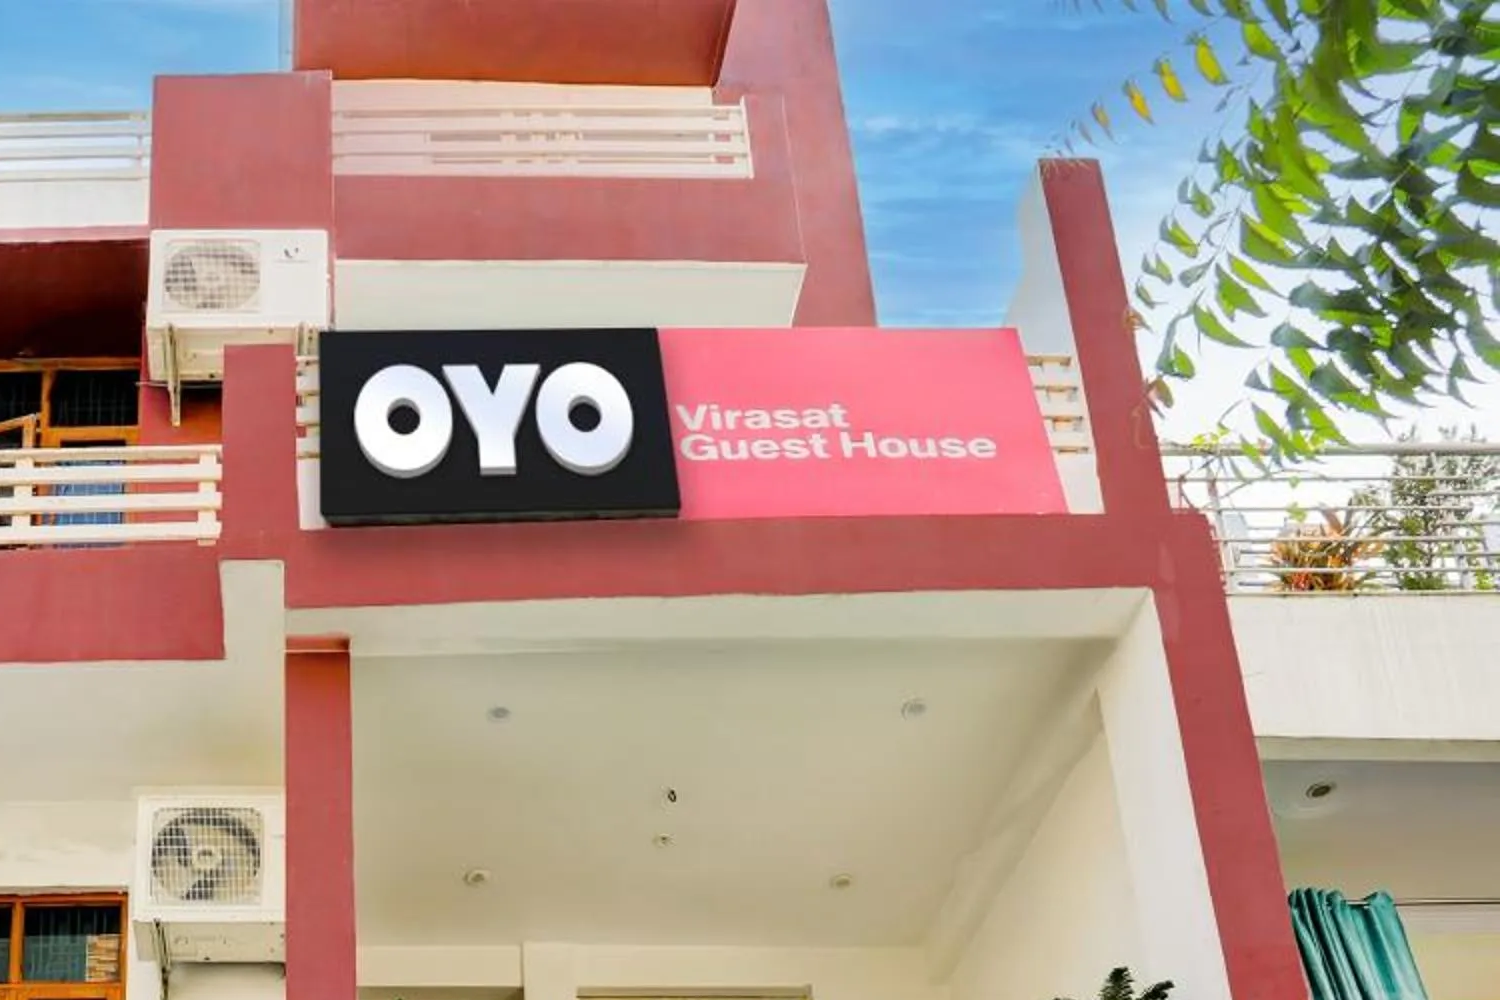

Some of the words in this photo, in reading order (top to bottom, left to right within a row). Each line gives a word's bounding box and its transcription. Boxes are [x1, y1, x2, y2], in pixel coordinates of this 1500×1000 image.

[354, 361, 634, 479] OYO
[676, 404, 850, 430] Virasat
[679, 434, 832, 460] Guest
[839, 432, 997, 458] House
